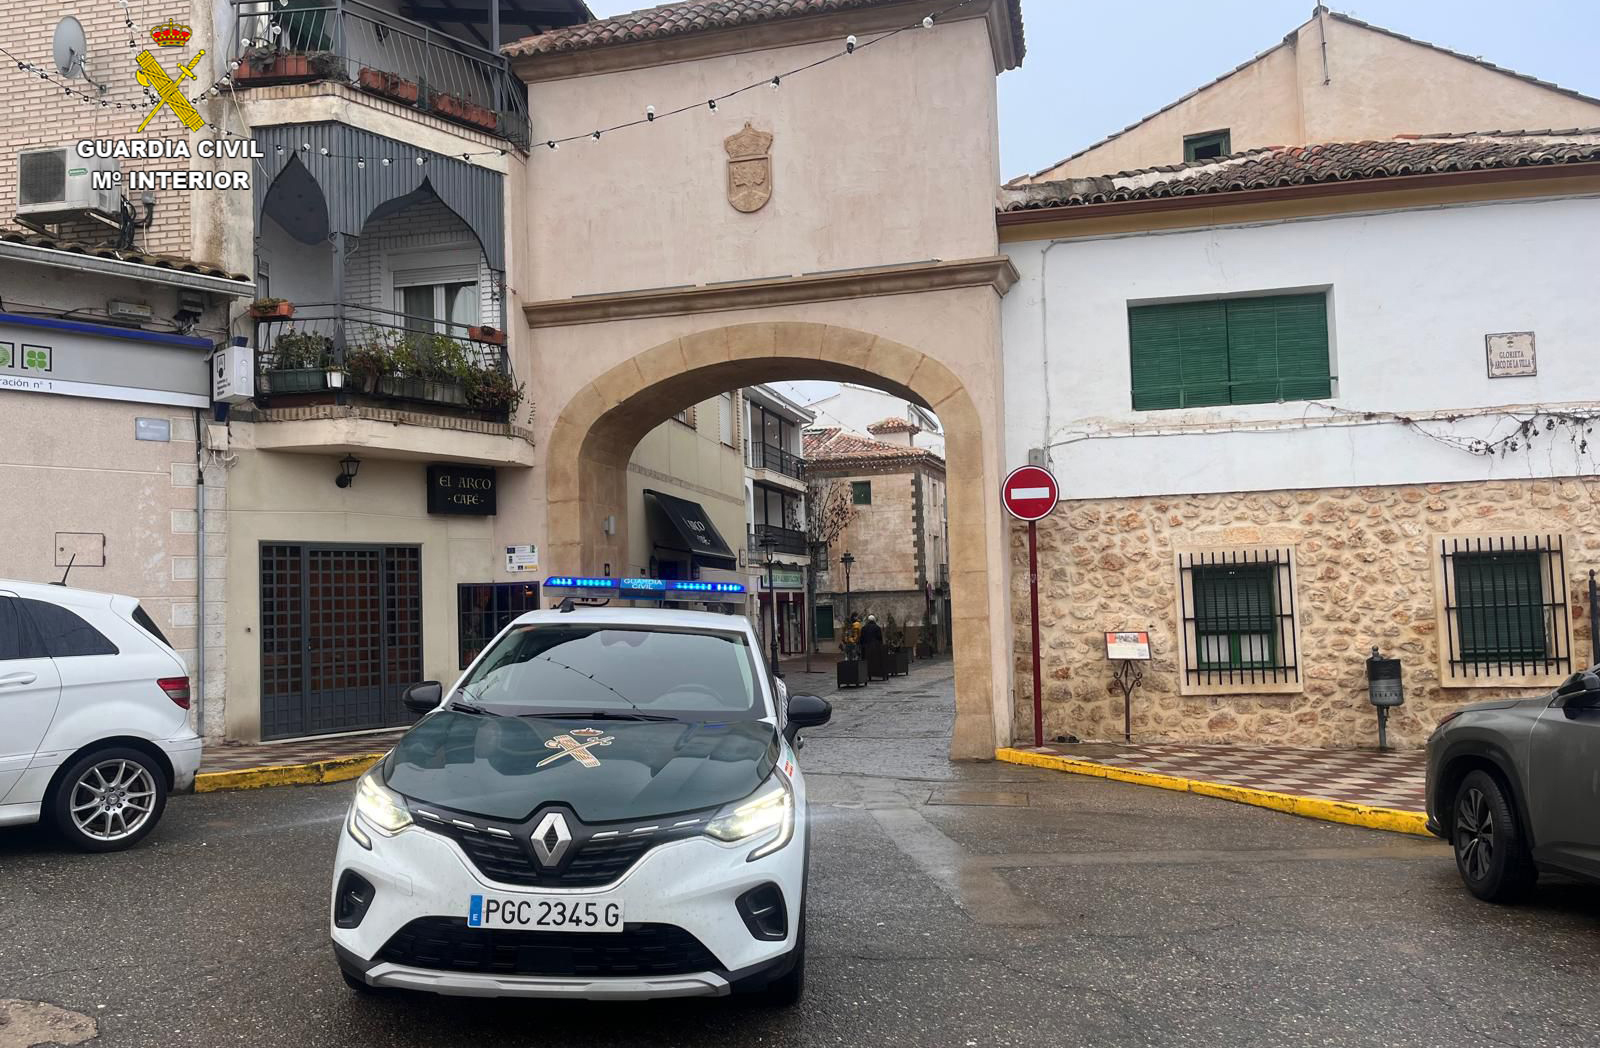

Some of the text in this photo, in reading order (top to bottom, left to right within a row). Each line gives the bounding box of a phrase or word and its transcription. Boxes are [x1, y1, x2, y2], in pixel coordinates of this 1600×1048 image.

[1499, 350, 1524, 359] GLORIETA
[459, 477, 491, 489] ARCO
[472, 899, 619, 927] E PGC 2345 G
